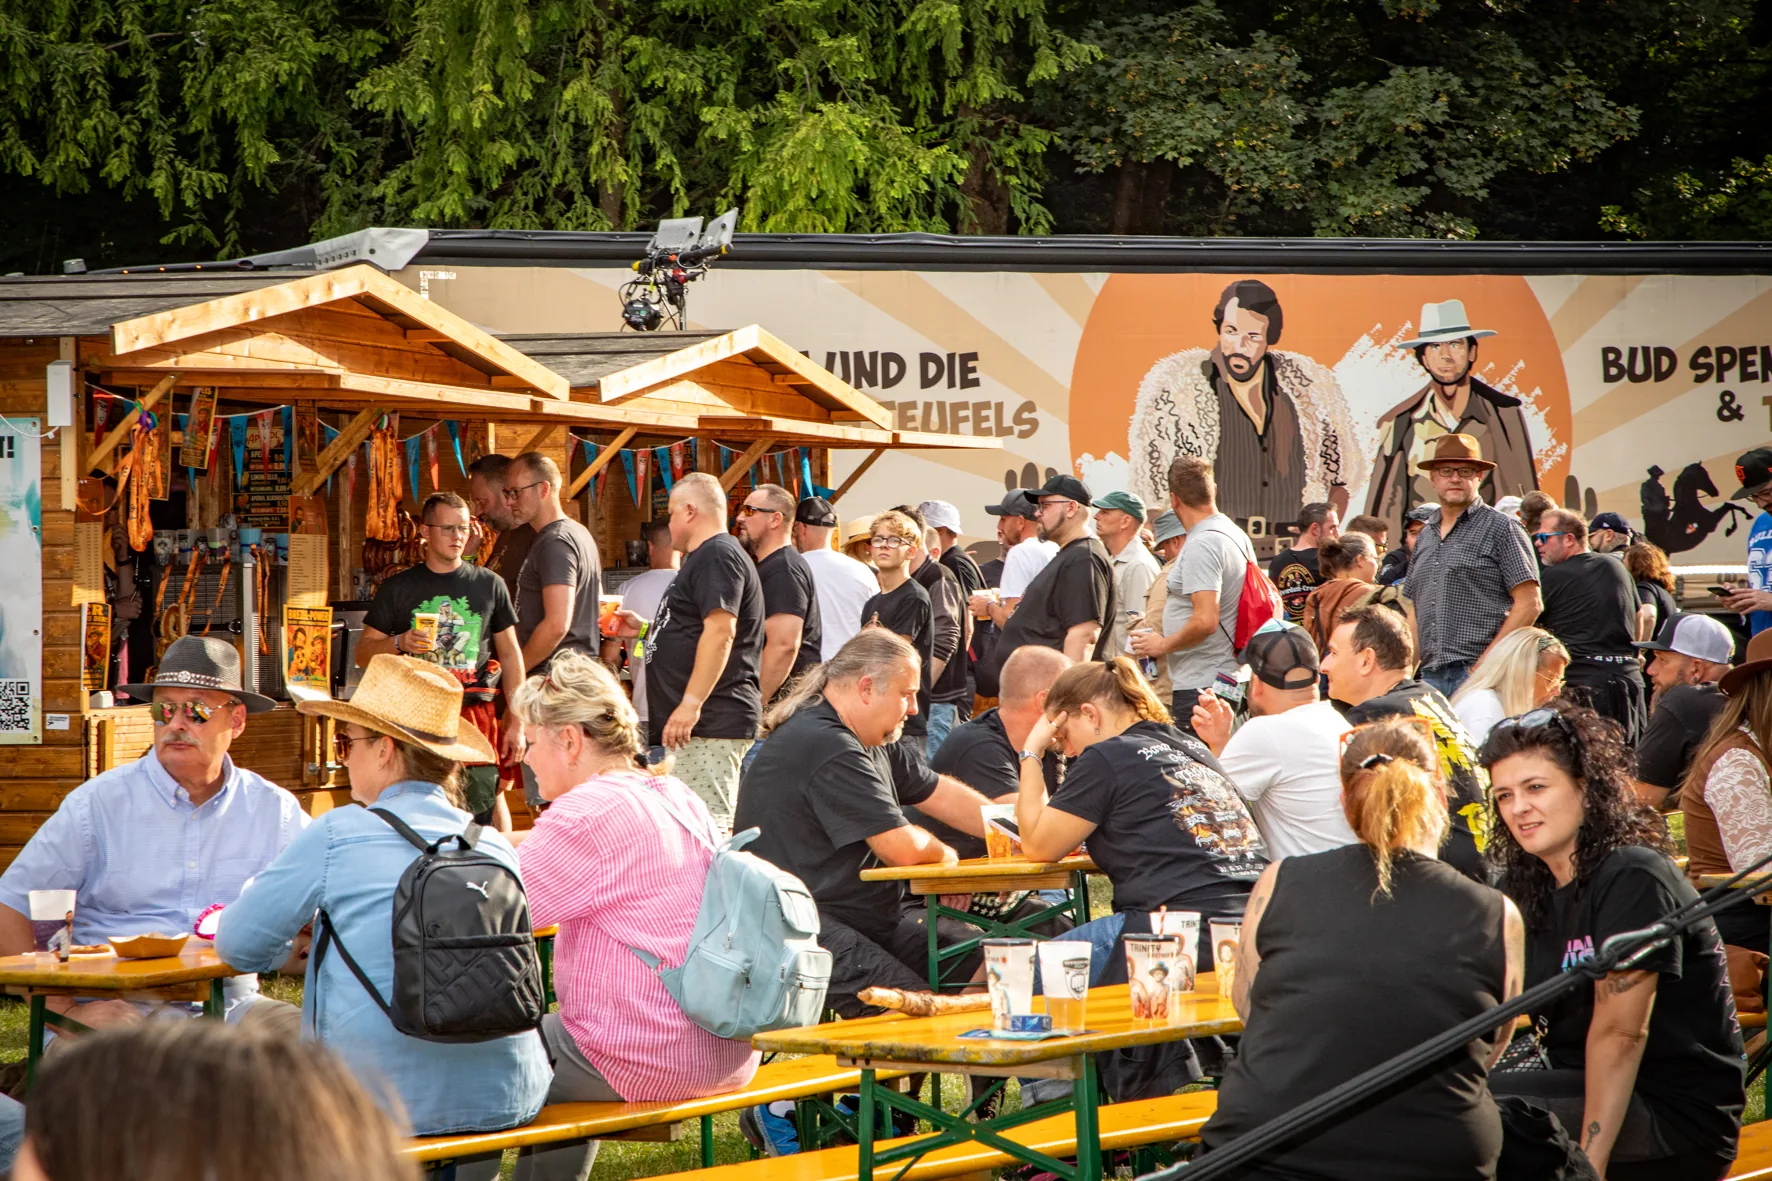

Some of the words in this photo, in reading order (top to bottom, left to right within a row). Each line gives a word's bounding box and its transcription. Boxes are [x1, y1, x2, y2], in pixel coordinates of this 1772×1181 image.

[824, 350, 907, 390] UND
[919, 351, 981, 390] DIE
[1601, 346, 1678, 383] BUD
[1716, 389, 1745, 422] &
[1130, 943, 1161, 953] TRINITY
